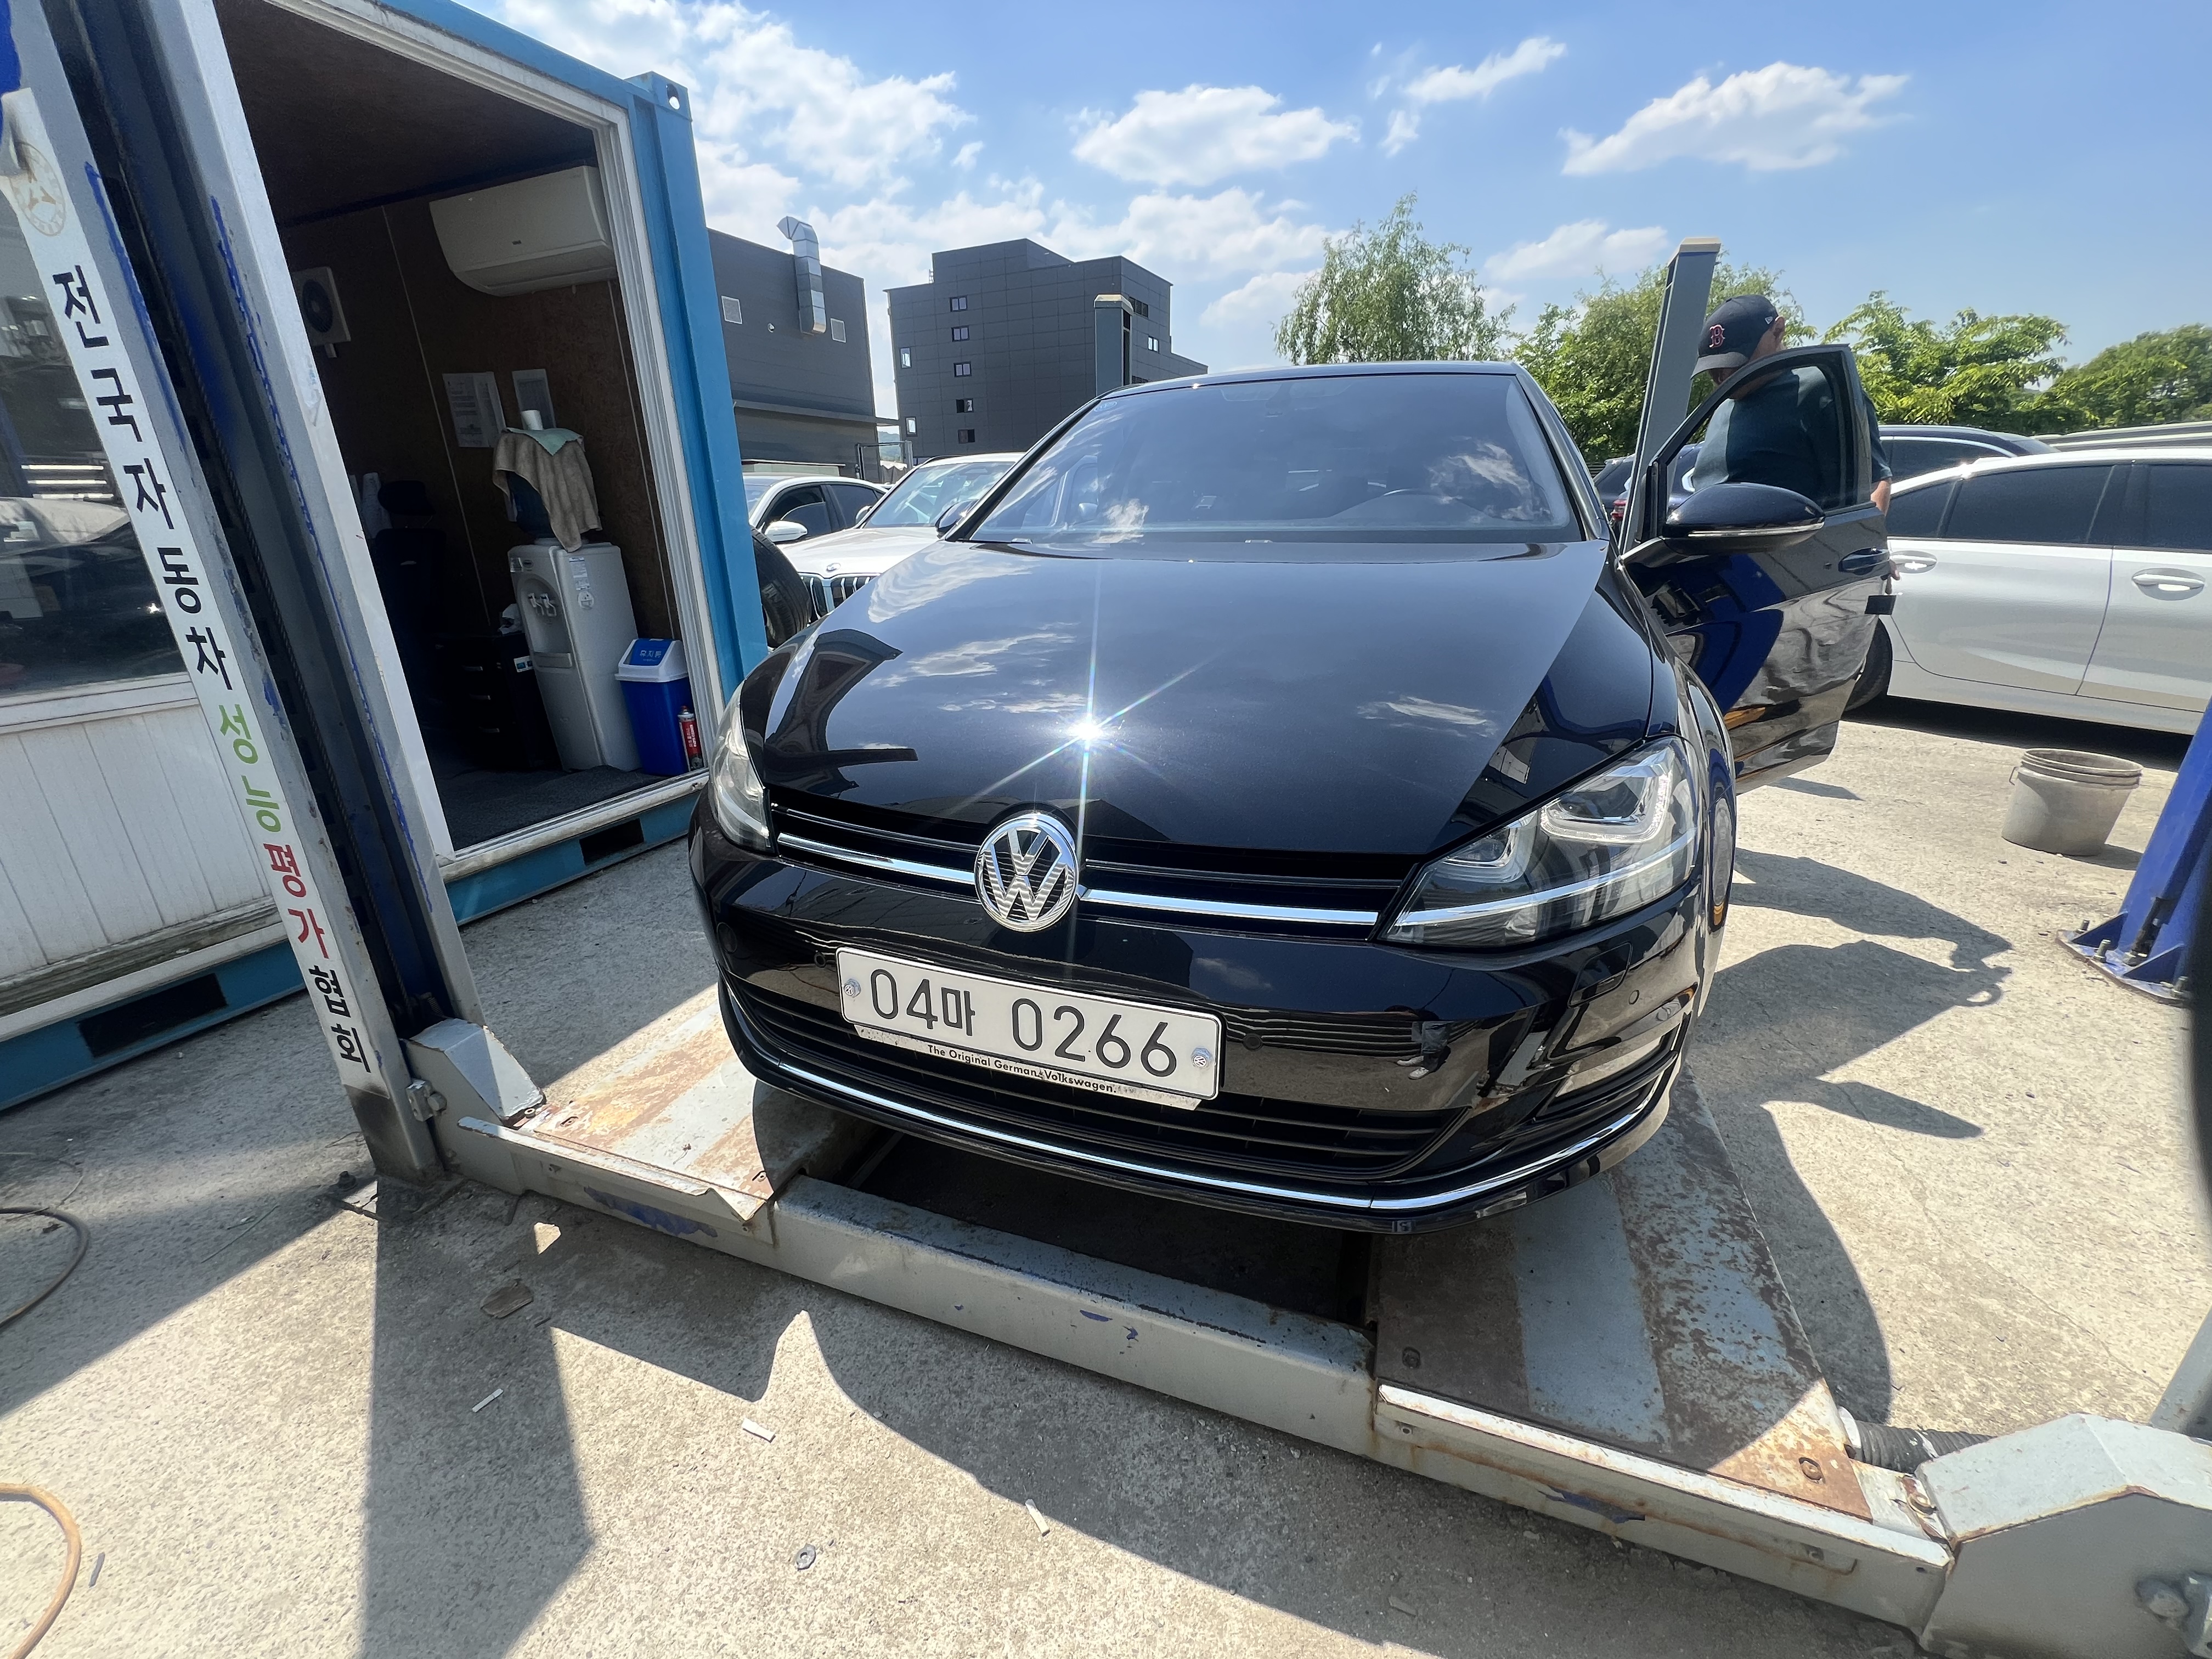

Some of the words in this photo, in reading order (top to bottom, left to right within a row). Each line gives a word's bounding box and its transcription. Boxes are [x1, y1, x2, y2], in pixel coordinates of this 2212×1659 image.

[1709, 324, 1725, 348] B
[982, 825, 1069, 923] VW
[870, 969, 976, 1036] 04마
[1012, 998, 1177, 1077] 0266
[927, 1044, 945, 1057] The
[949, 1049, 991, 1066] Original
[1043, 1069, 1116, 1093] Volkswagen.
